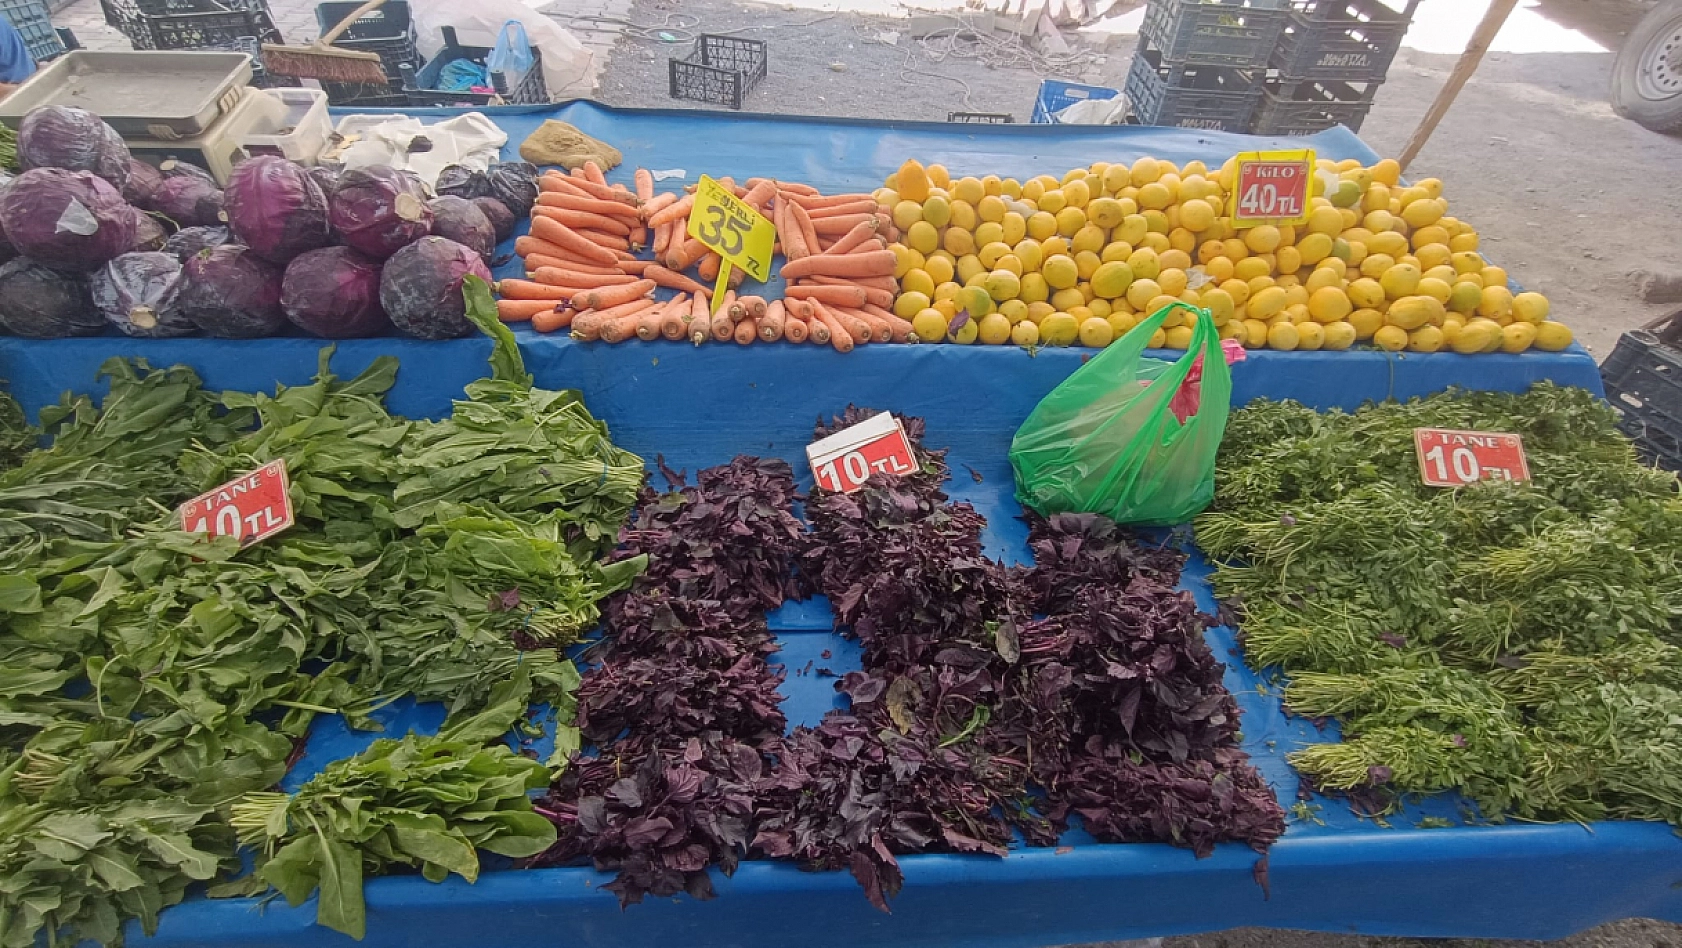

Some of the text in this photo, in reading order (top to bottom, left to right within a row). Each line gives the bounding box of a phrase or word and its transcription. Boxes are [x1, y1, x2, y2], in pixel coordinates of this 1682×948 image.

[1240, 183, 1299, 214] 40 TL
[699, 205, 752, 256] 35
[1437, 433, 1499, 449] TANE
[820, 450, 909, 493] 10 TL
[1426, 445, 1480, 482] 10
[202, 473, 262, 511] TANE
[244, 506, 283, 535] TL
